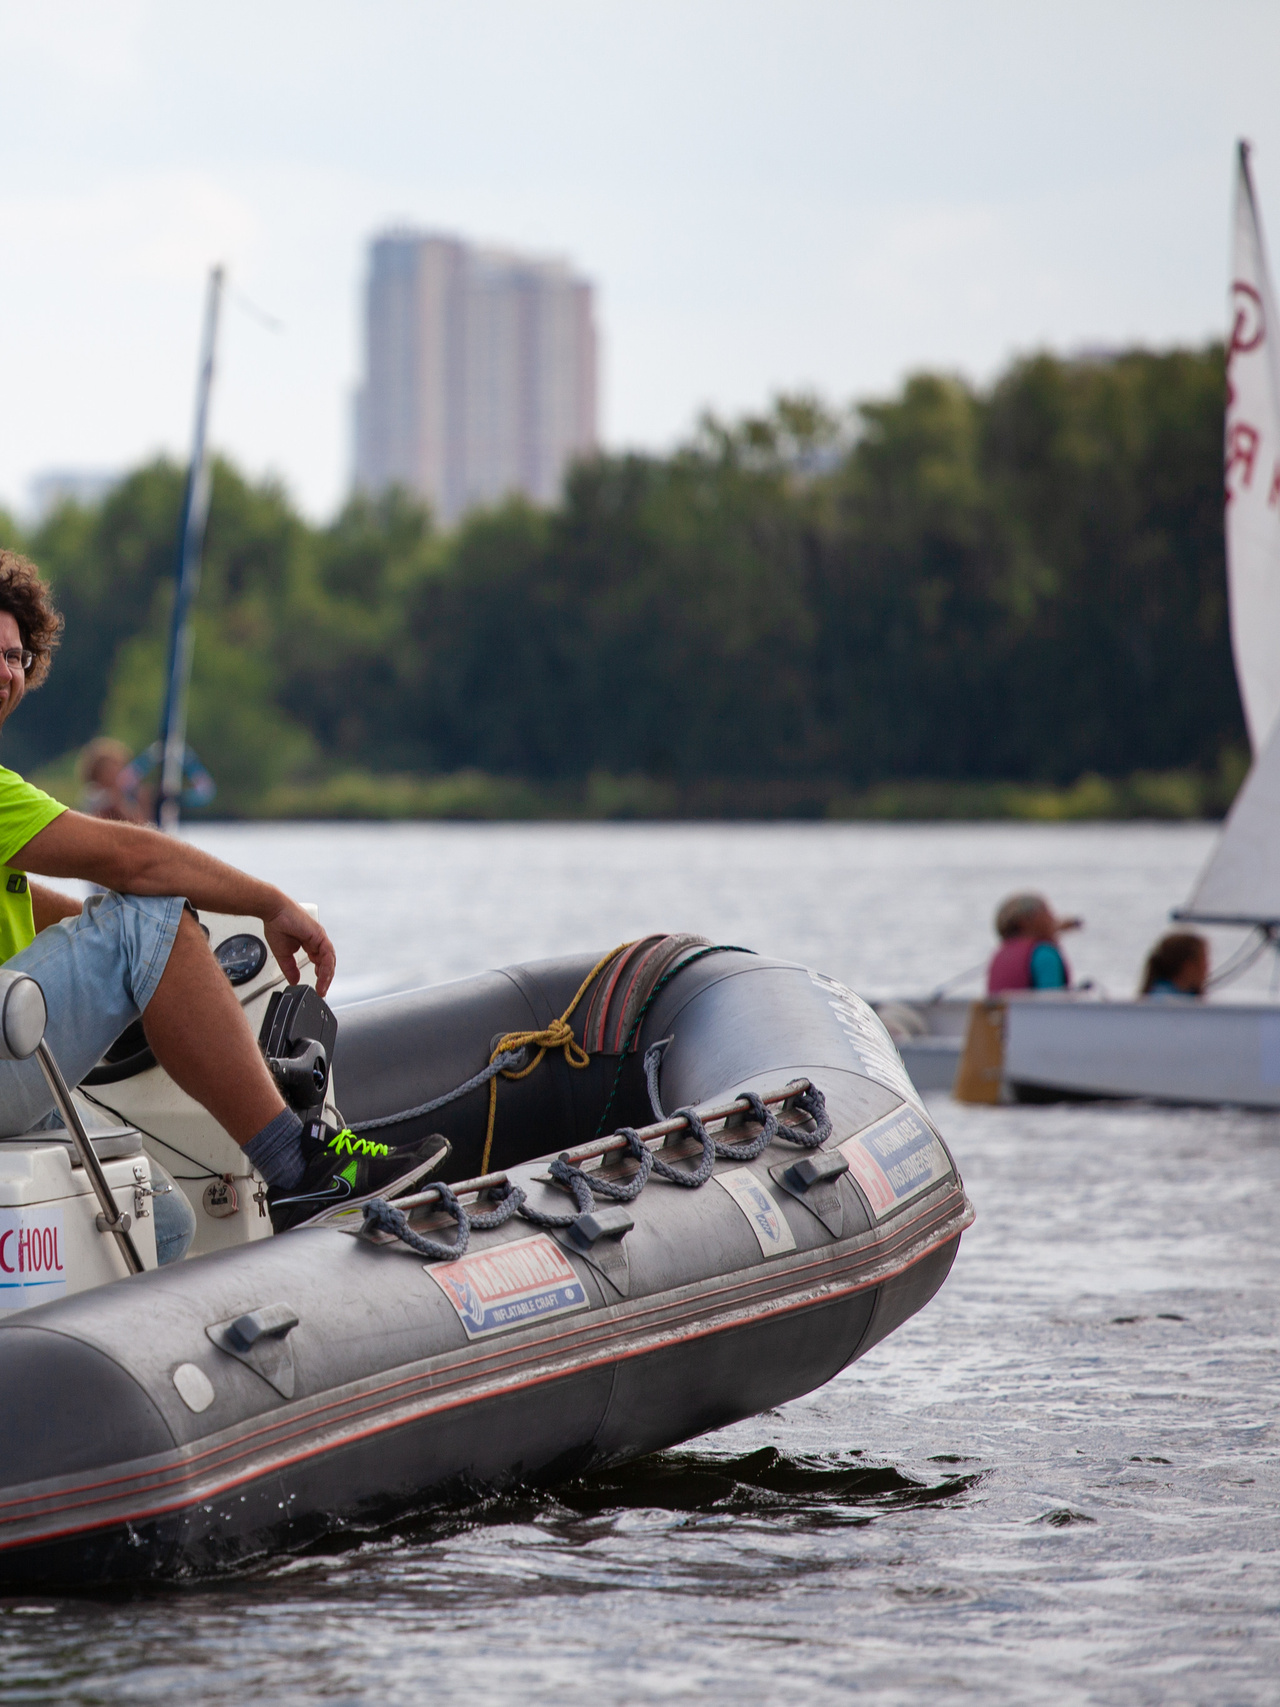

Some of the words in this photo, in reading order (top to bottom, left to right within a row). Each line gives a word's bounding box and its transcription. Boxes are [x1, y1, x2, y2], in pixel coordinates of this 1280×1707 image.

[871, 1116, 923, 1158] UNSINKABLE
[464, 1242, 570, 1298] NARWHAL
[492, 1300, 537, 1323] INFLATABLE
[535, 1293, 559, 1312] CRAFT
